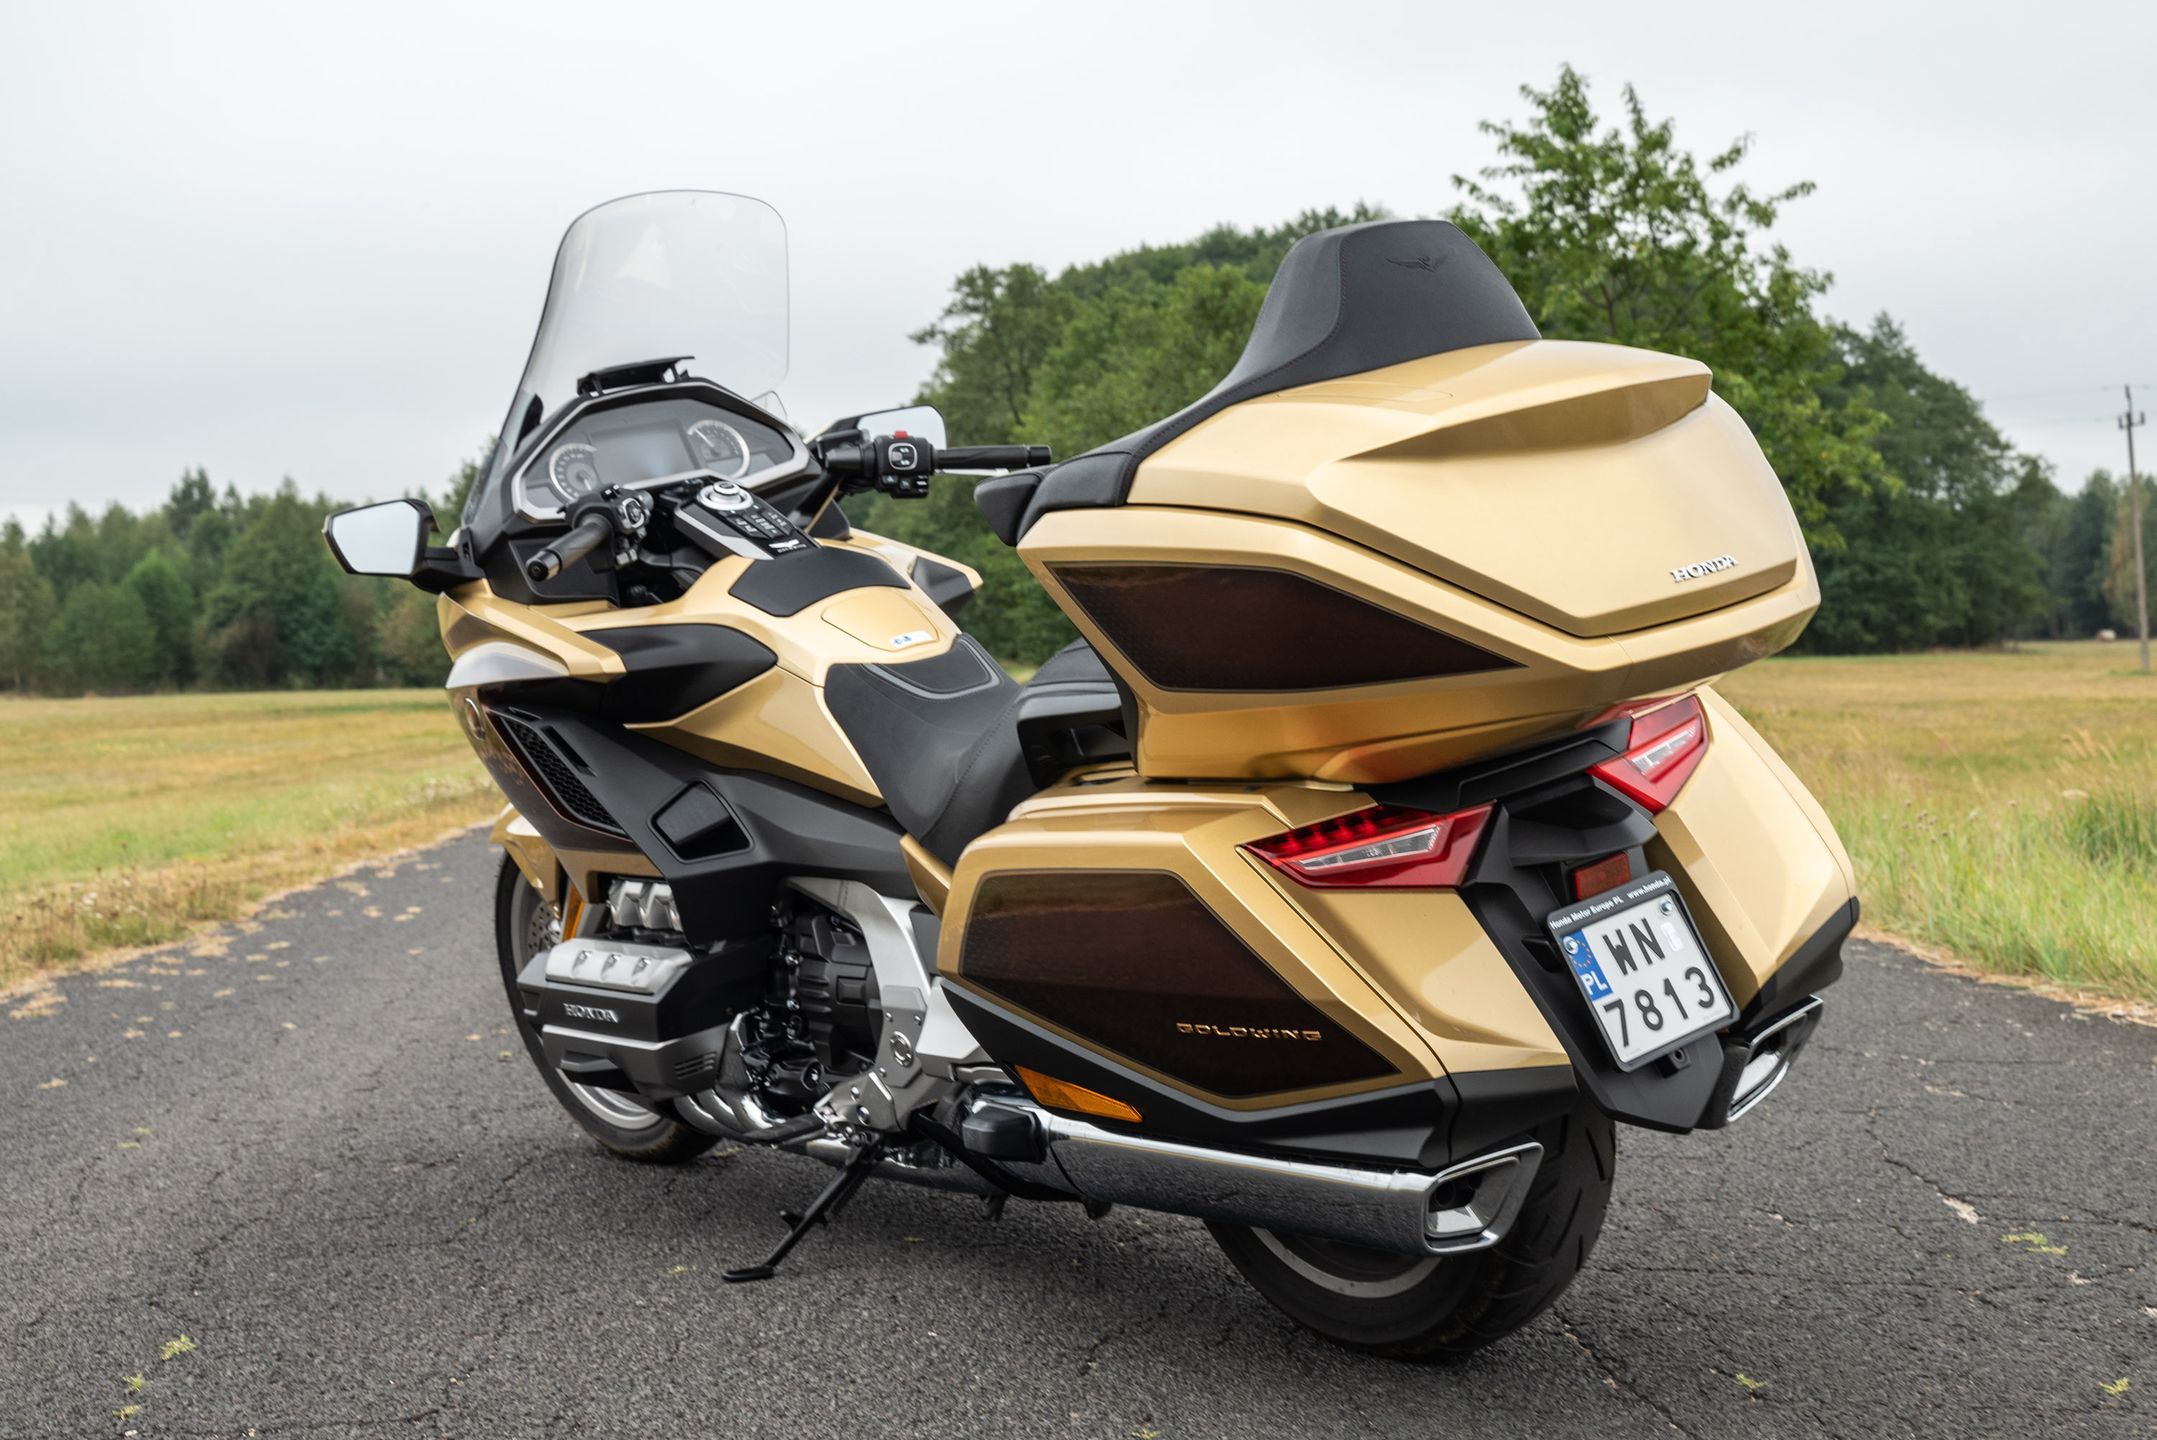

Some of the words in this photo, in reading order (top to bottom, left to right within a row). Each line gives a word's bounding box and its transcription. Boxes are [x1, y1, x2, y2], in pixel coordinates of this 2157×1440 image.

[1669, 553, 1739, 583] HONDA
[1626, 875, 1672, 899] www.honda.pl
[1549, 915, 1573, 930] Honda
[1570, 908, 1592, 922] Motor
[1589, 901, 1615, 914] Europe
[1612, 895, 1625, 905] PL
[1601, 917, 1667, 976] WN
[1581, 971, 1608, 995] PL
[563, 1002, 619, 1024] HONDA
[1603, 966, 1715, 1048] 7813
[1176, 1022, 1322, 1041] GOLDWING
